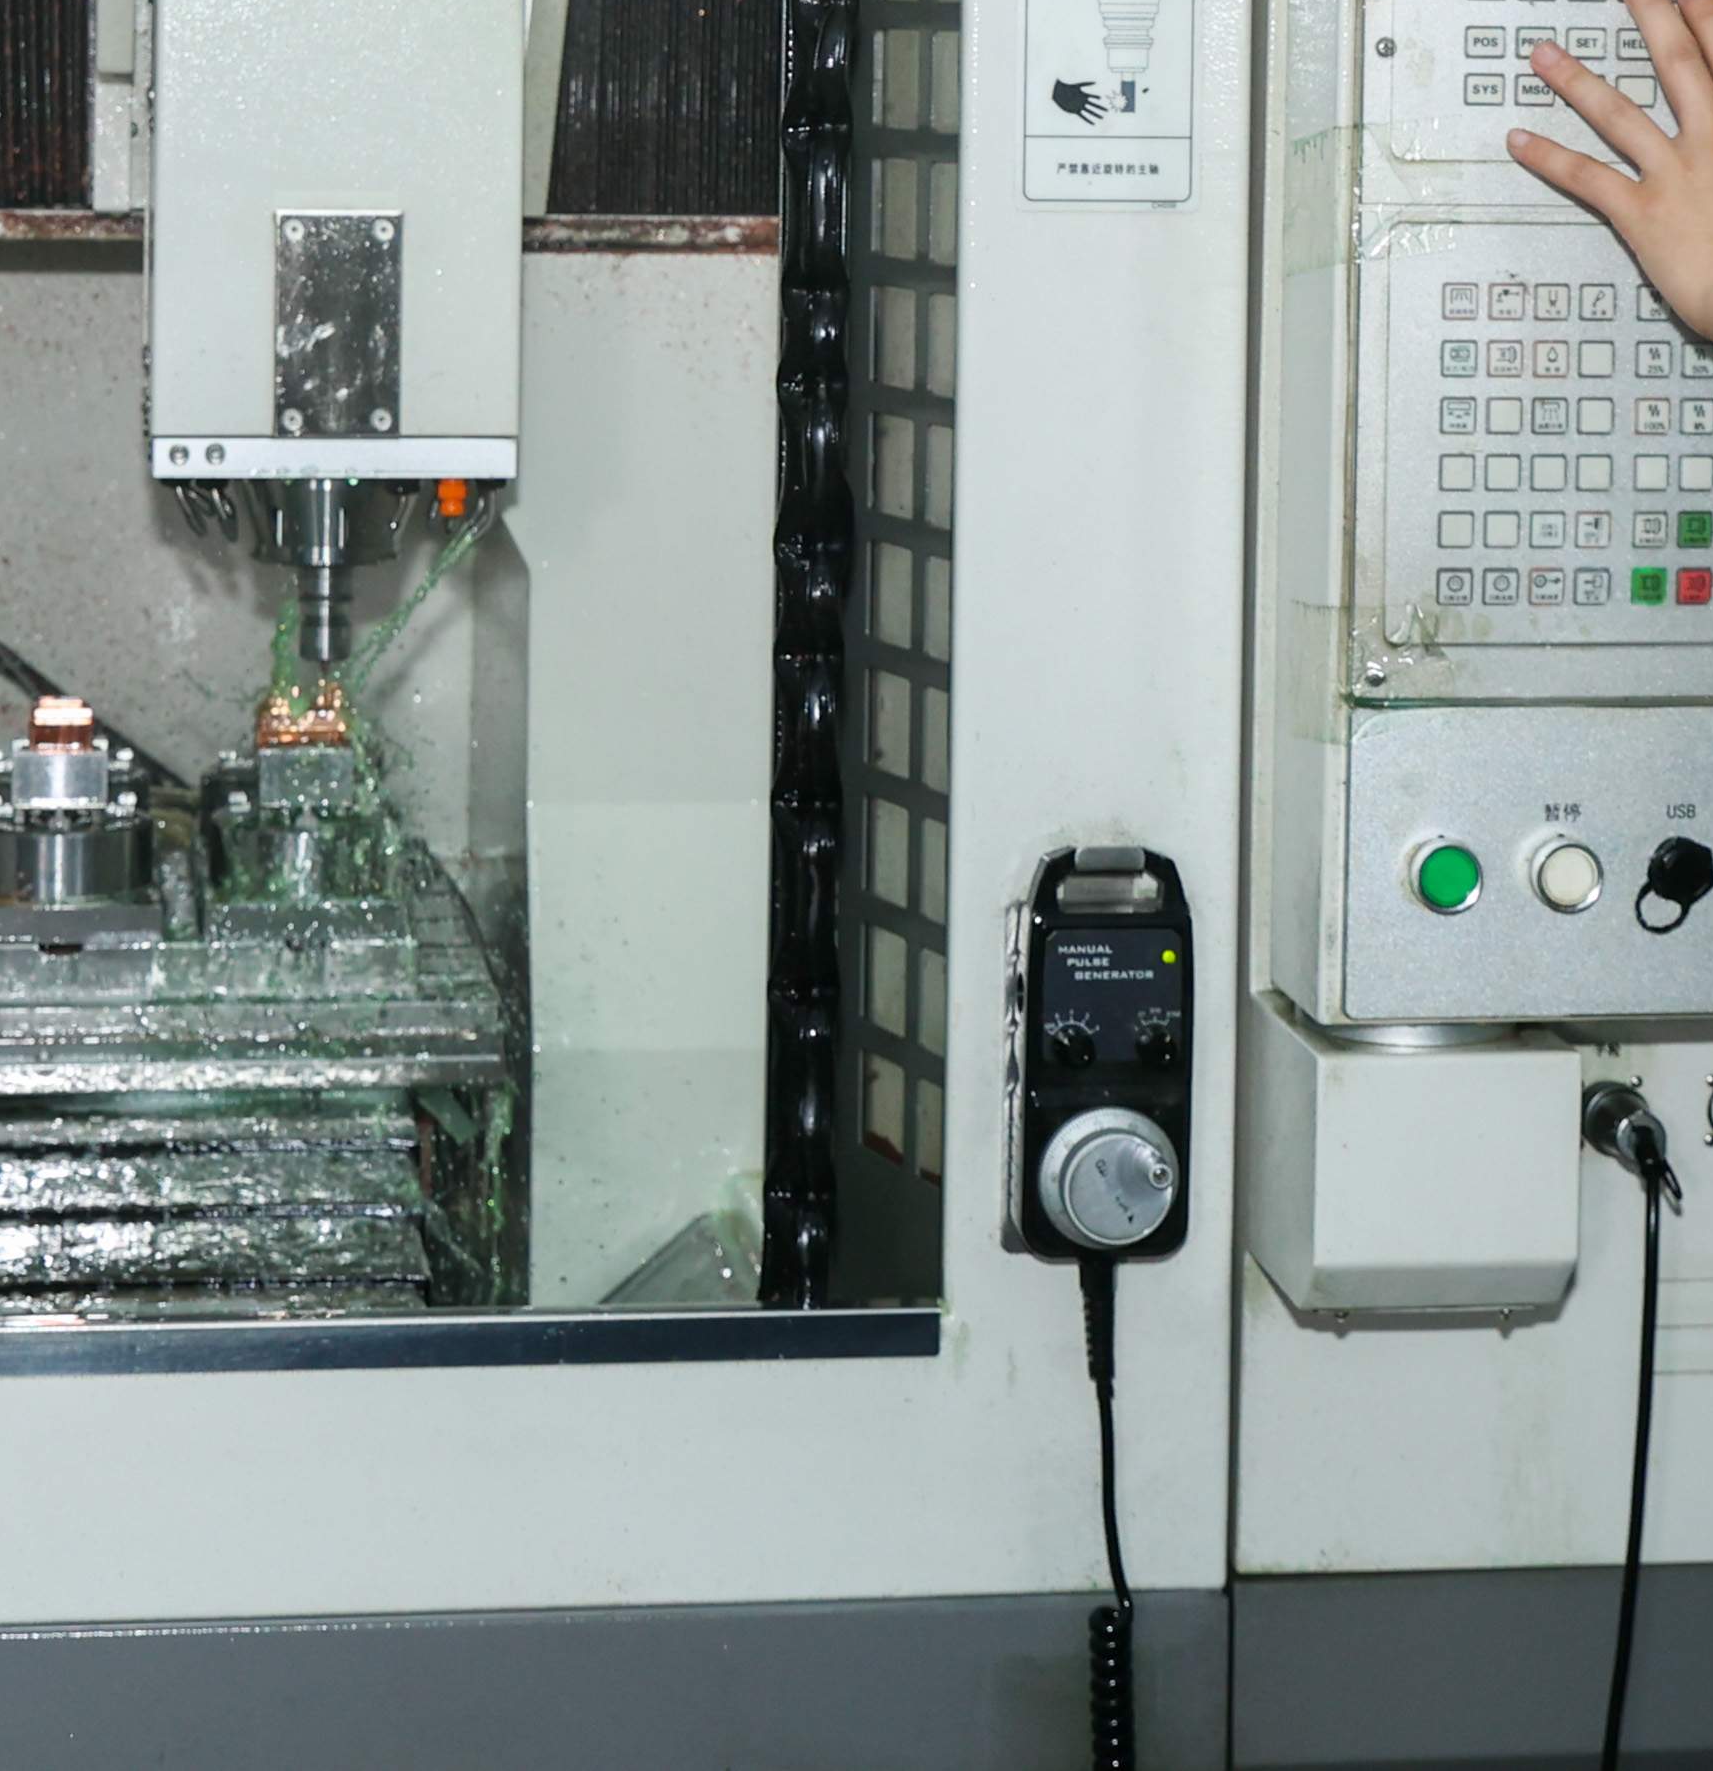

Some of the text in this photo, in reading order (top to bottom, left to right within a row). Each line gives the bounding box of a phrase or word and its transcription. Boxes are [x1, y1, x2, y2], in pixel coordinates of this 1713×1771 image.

[1473, 37, 1498, 48] POS
[1576, 38, 1597, 49] SET
[1472, 85, 1498, 96] SYS
[1522, 85, 1551, 96] MSG
[1545, 803, 1581, 822] 暂停
[1667, 804, 1696, 819] USB
[1058, 944, 1113, 954] MANUAL
[1067, 958, 1109, 967] PULSE
[1075, 970, 1154, 980] GENERATOR
